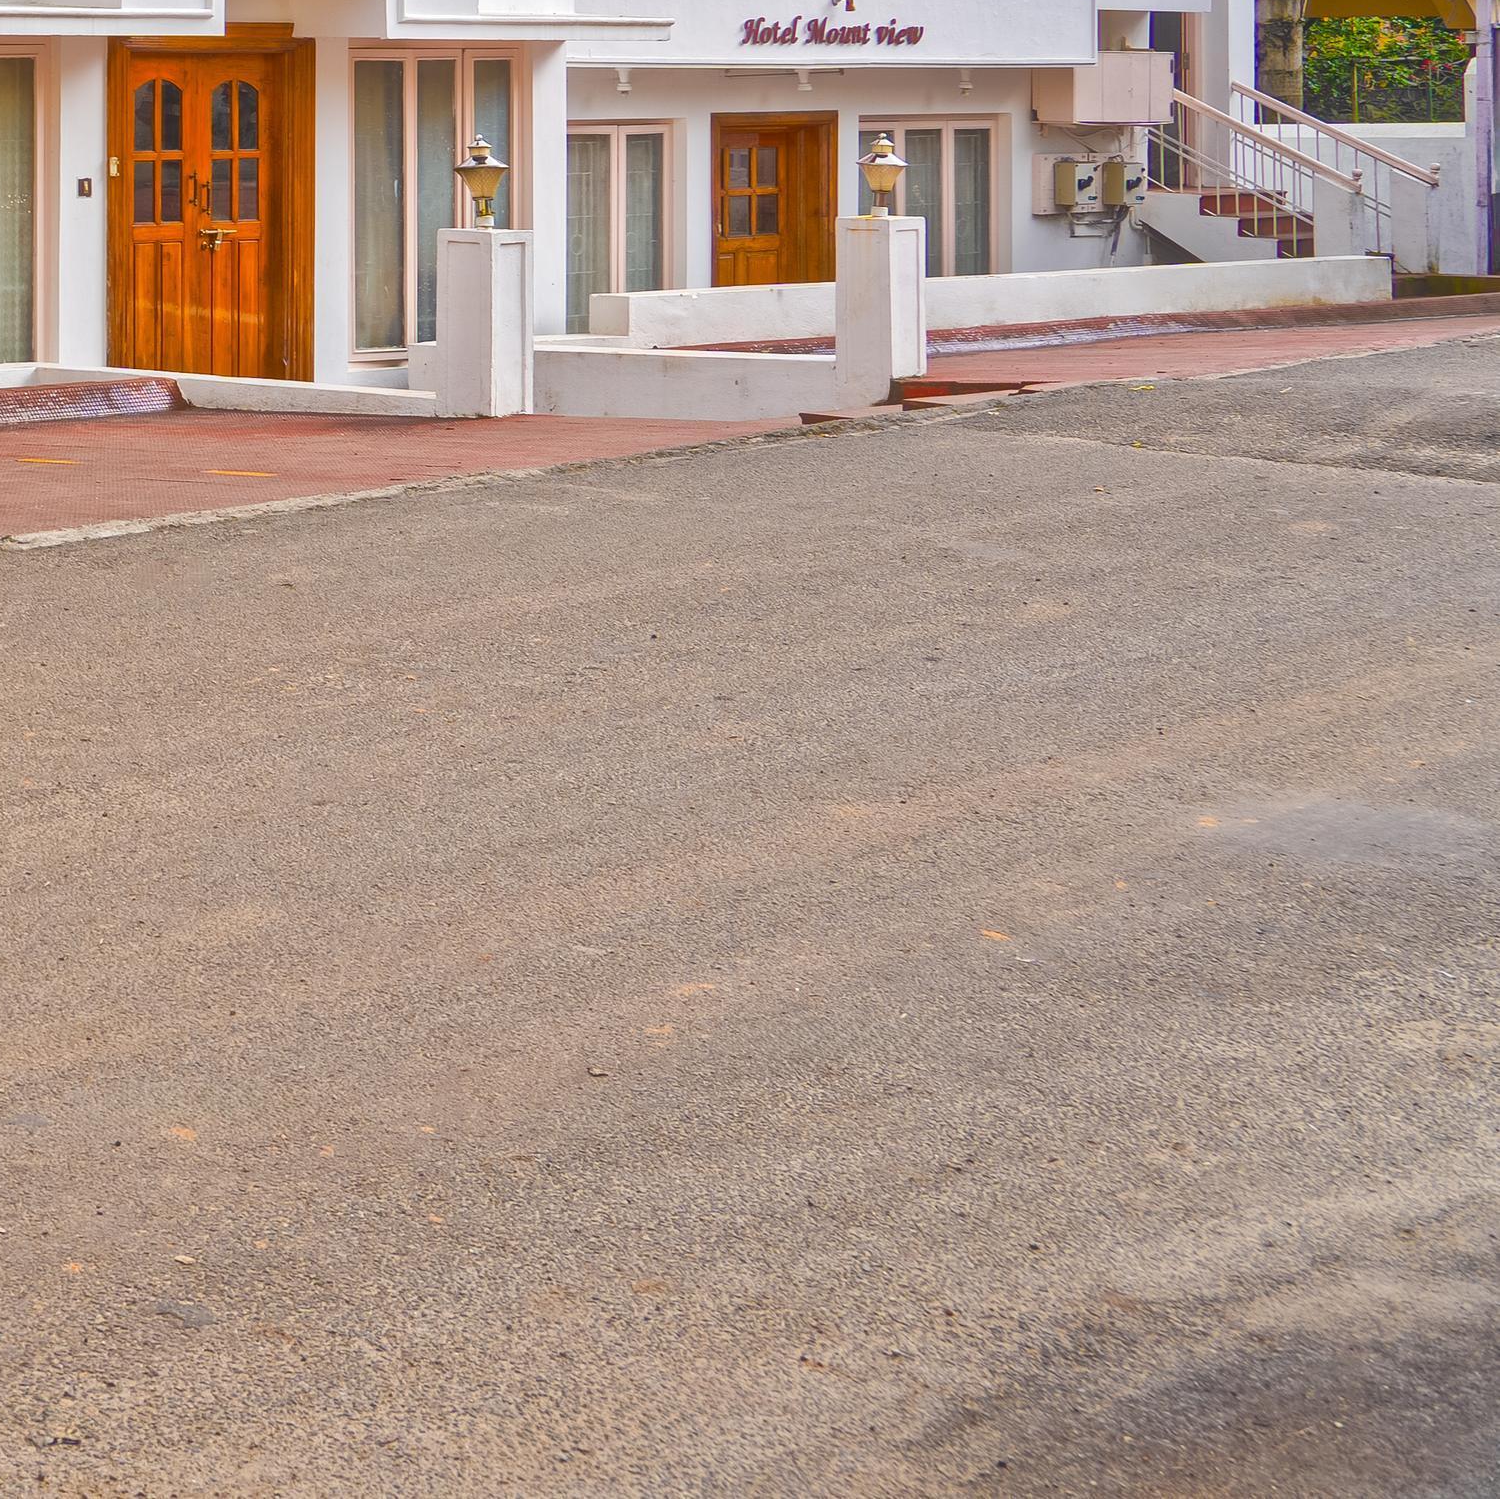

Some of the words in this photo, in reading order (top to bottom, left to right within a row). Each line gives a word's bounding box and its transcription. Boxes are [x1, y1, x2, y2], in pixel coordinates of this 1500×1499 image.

[742, 15, 802, 45] Hotel
[804, 16, 870, 45] Mount
[876, 18, 924, 46] view
